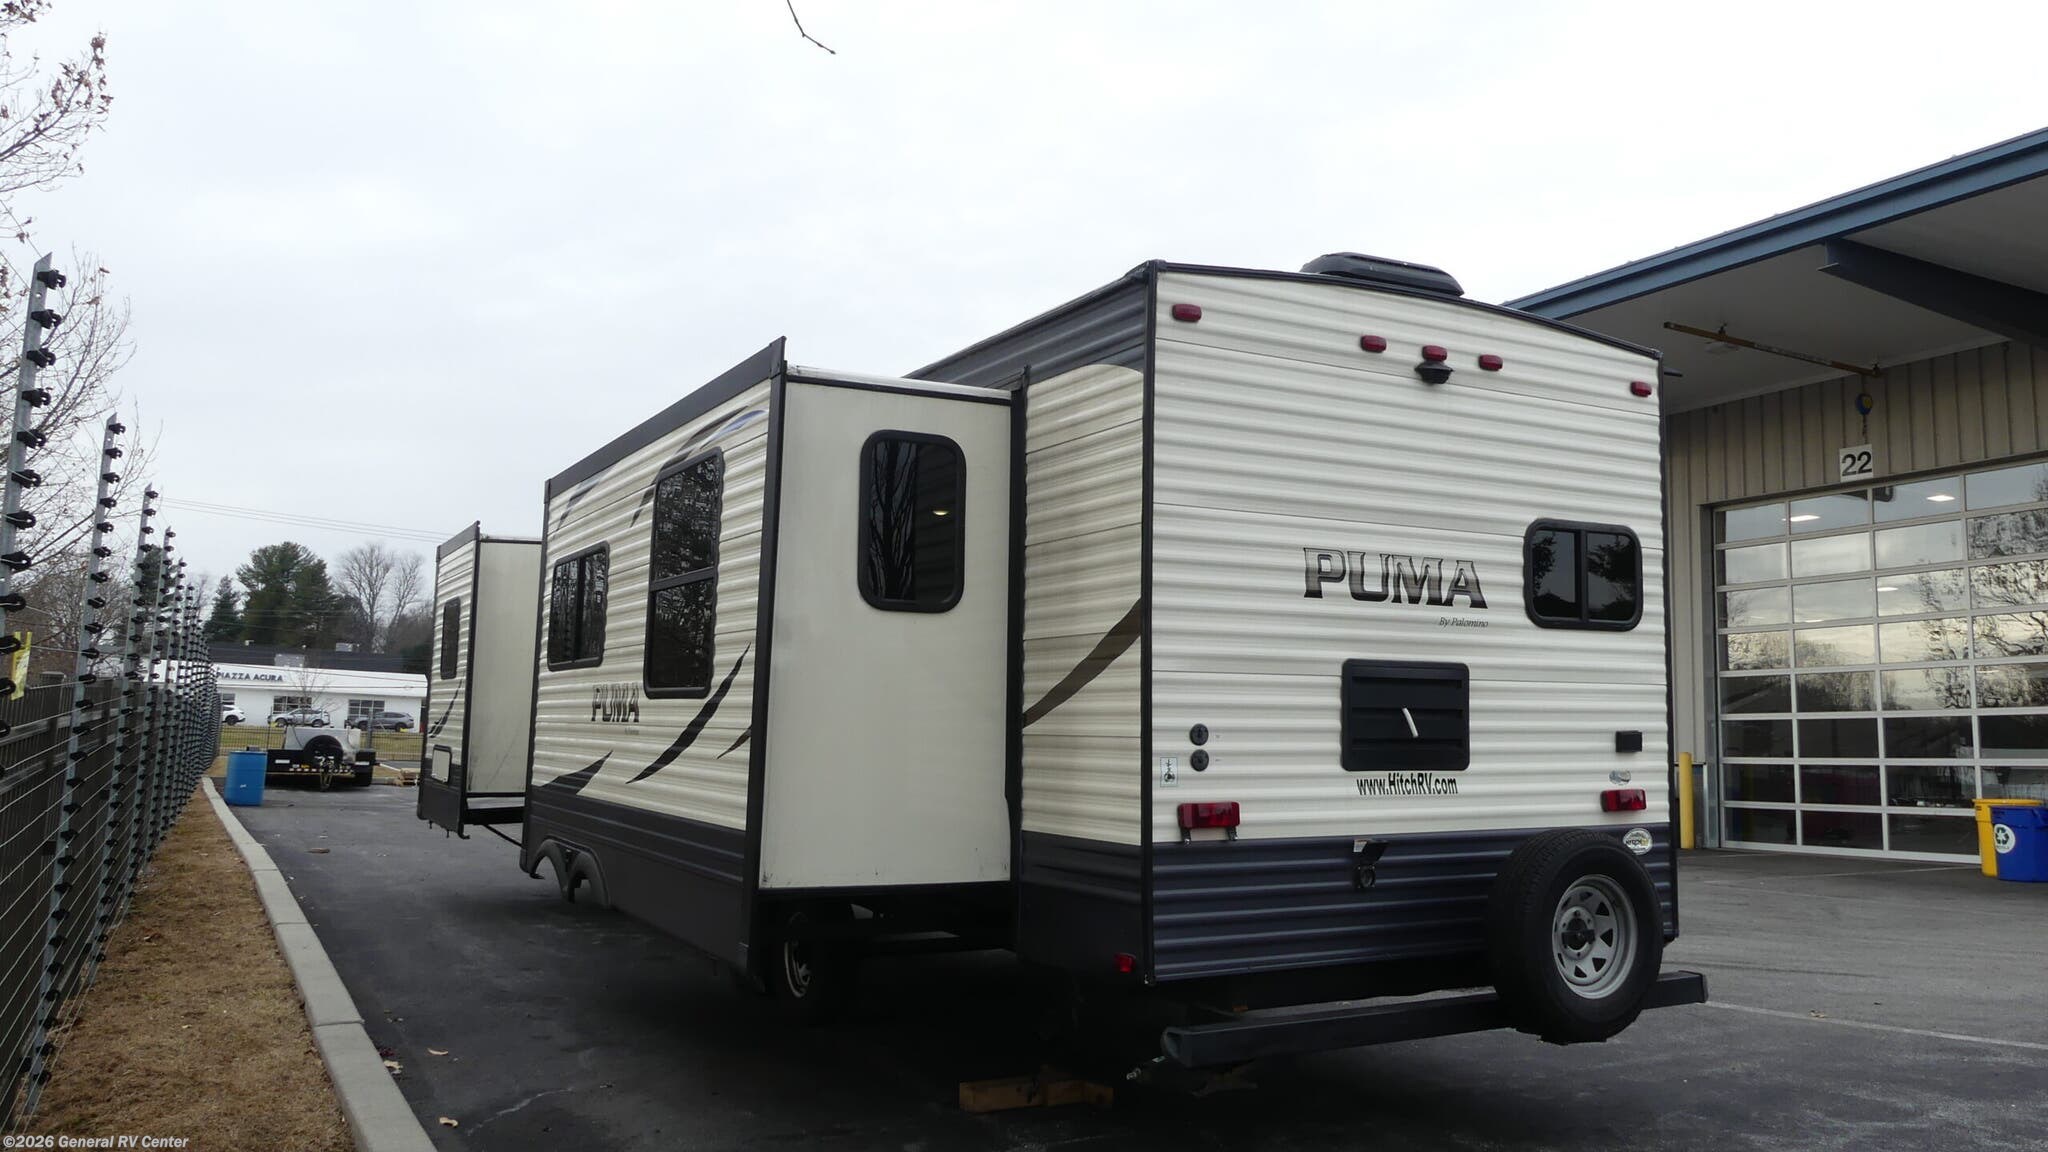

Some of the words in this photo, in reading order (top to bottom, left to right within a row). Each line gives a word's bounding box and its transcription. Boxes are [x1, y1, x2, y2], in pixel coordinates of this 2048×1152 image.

[1842, 451, 1872, 476] 22
[1304, 548, 1488, 609] PUMA
[1439, 617, 1450, 627] By
[1451, 617, 1488, 628] Palomino
[216, 672, 251, 680] PIAZZA
[253, 674, 283, 682] ACURA
[591, 683, 640, 722] PUMA
[1357, 773, 1458, 795] www.HitchRV.com
